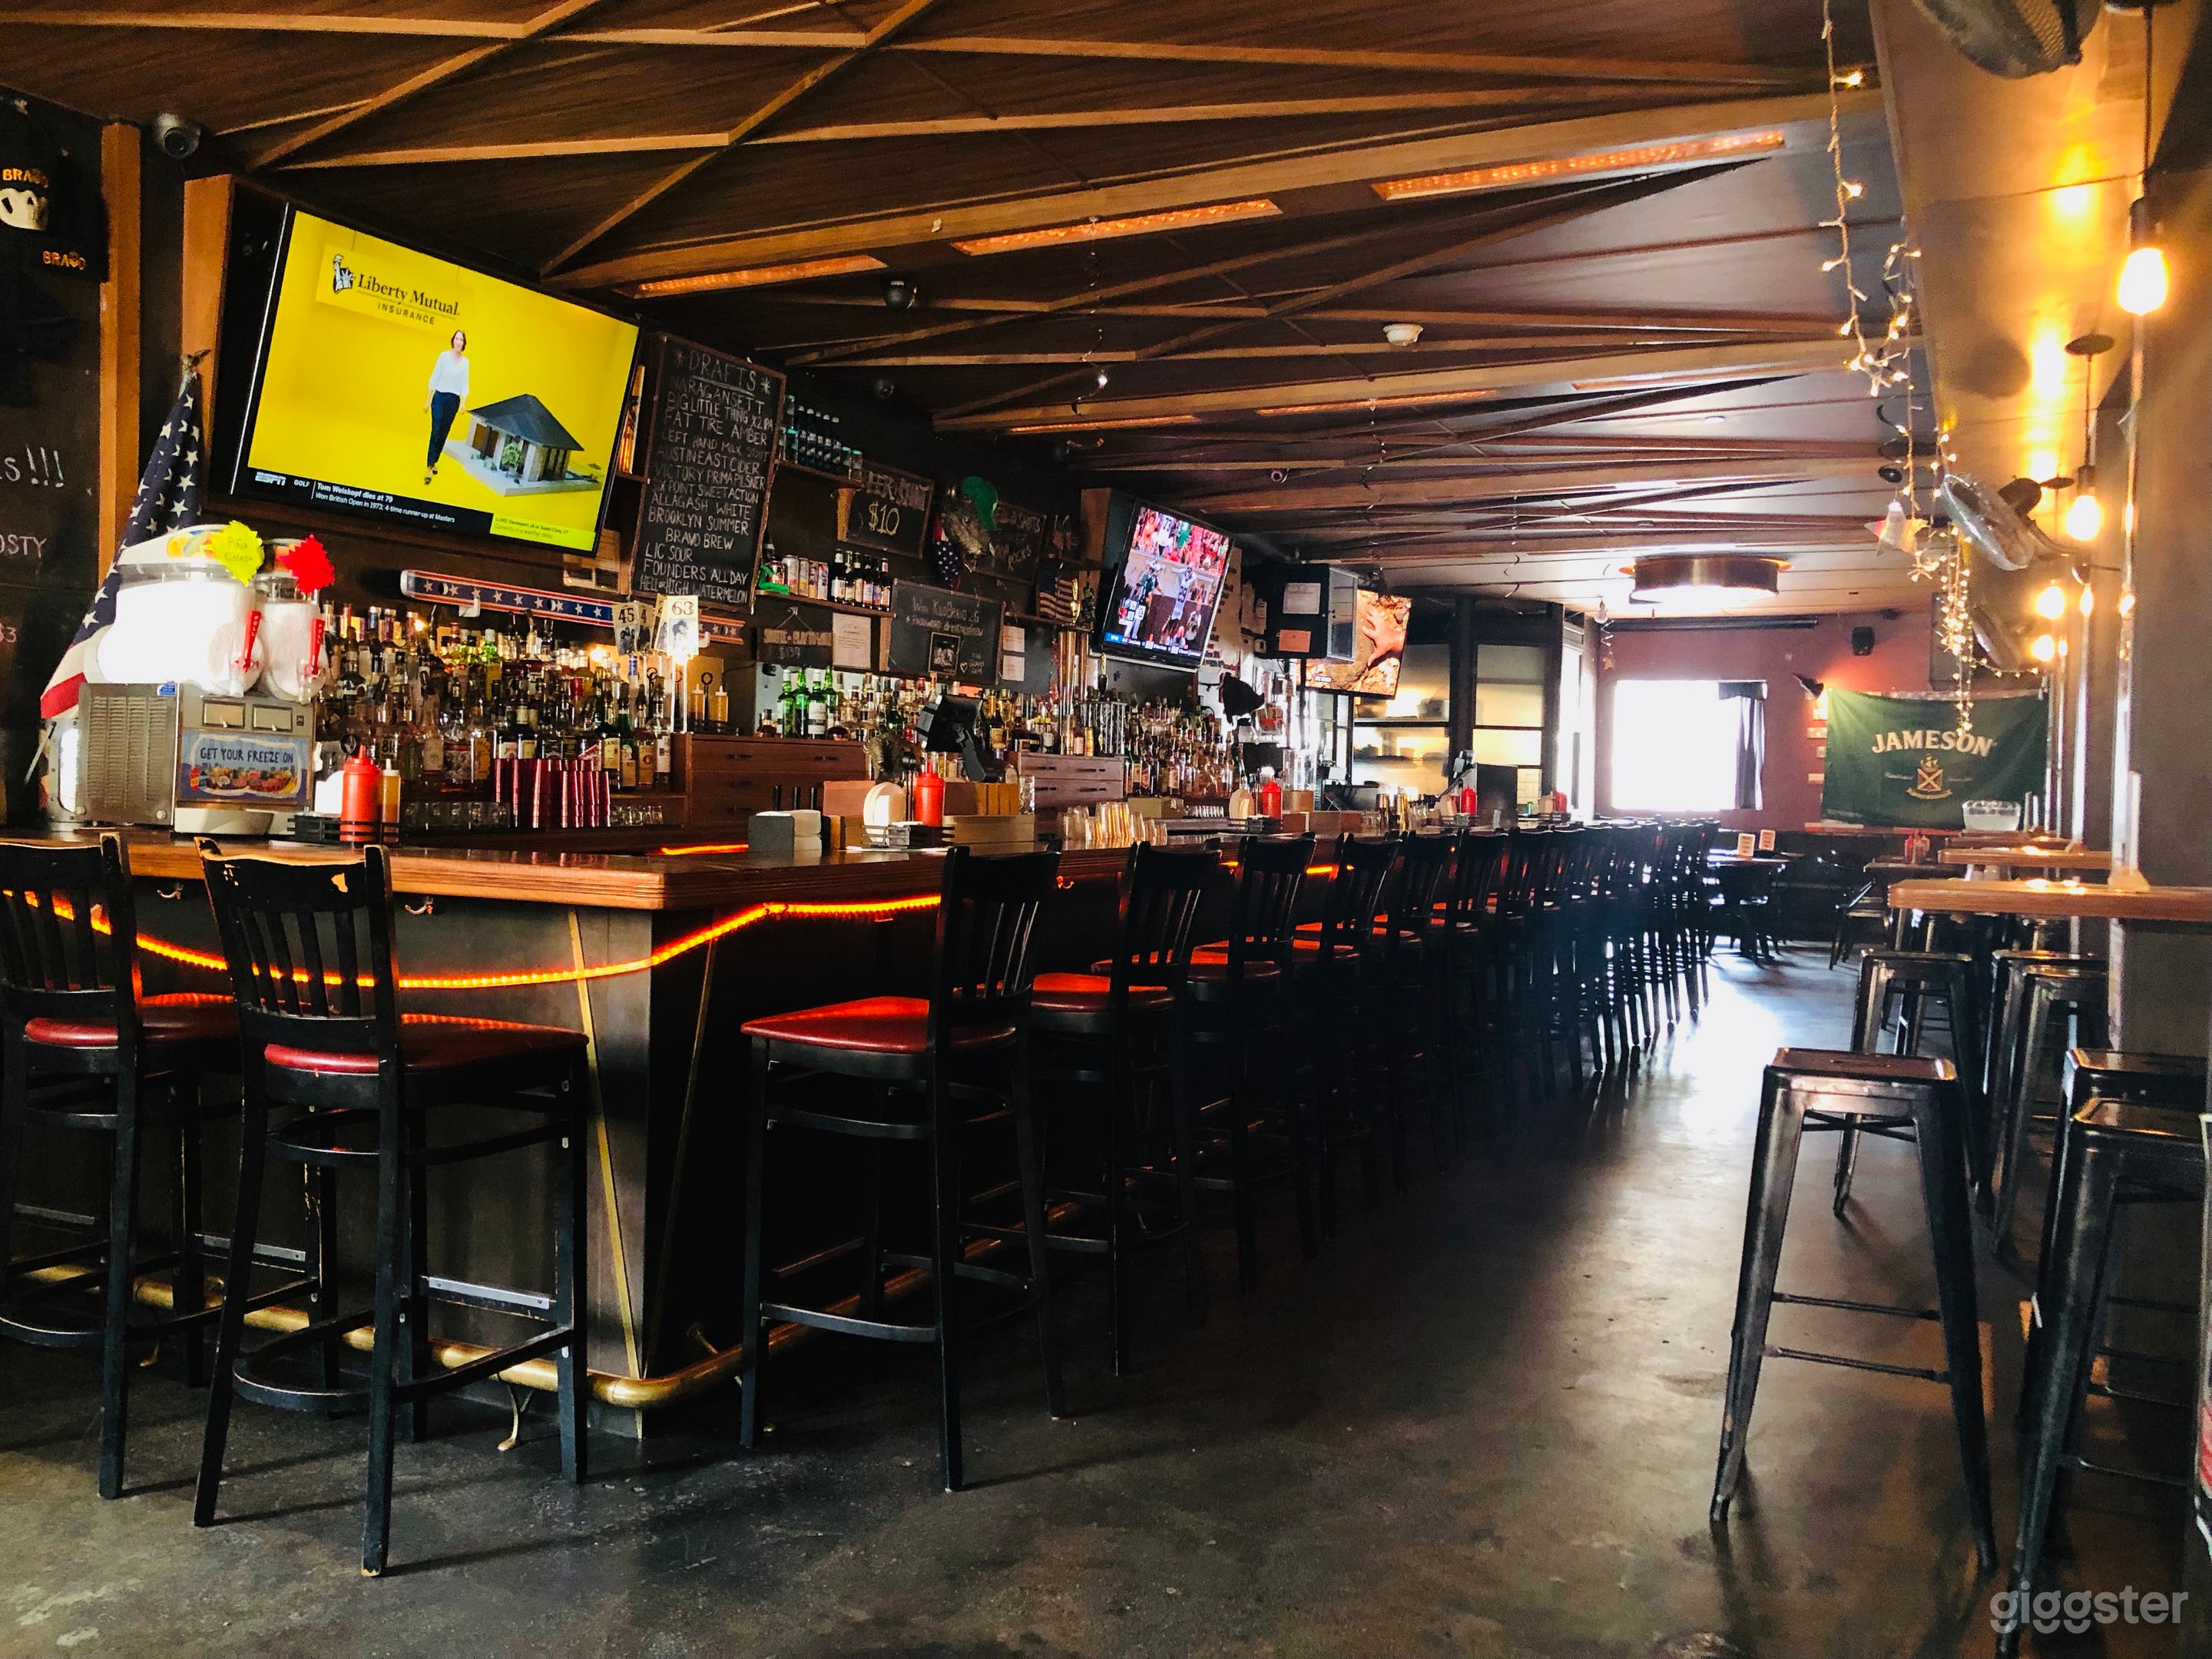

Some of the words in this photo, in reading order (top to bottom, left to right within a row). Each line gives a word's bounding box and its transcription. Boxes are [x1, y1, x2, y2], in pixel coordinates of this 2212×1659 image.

[358, 273, 409, 305] Liberty
[410, 290, 459, 316] Mutual
[377, 302, 435, 325] INSURANCE
[689, 350, 757, 392] DRAFTS
[667, 391, 689, 410] BIG
[691, 398, 720, 418] LITTLE
[661, 429, 689, 445] LEFT
[693, 435, 718, 450] HAND
[664, 408, 693, 428] FAT
[730, 424, 768, 446] AMBER
[654, 462, 703, 483] VICTORY
[730, 456, 760, 475] CIDER
[254, 471, 286, 486] ESPN
[293, 478, 310, 488] GOLF
[317, 482, 331, 492] Tom
[363, 491, 376, 501] dies
[385, 495, 393, 503] 79
[668, 479, 694, 495] POINT
[728, 488, 760, 505] ACTION
[315, 492, 329, 500] Won
[329, 494, 348, 504] British
[348, 498, 363, 508] Open
[435, 513, 455, 523] Masters
[651, 491, 709, 512] ALLAGASH
[716, 501, 752, 521] WHITE
[868, 501, 900, 536] $10
[648, 505, 702, 529] BROOKLYN
[706, 515, 749, 536] SUMMER
[645, 541, 664, 559] LIC
[667, 546, 694, 562] SOUR
[665, 527, 701, 547] BRAVO
[703, 533, 734, 550] BREW
[644, 558, 707, 581] FOUNDERS
[710, 568, 729, 584] ALL
[730, 570, 749, 586] DAY
[639, 574, 658, 592] HELL
[665, 579, 689, 596] HIGH
[692, 584, 749, 604] WATERMELON
[618, 607, 635, 624] 45
[671, 601, 695, 616] 63
[200, 747, 219, 760] GET
[220, 747, 244, 761] YOUR
[247, 750, 280, 764] FREEZE
[283, 753, 293, 763] ON
[1871, 729, 1993, 758] JAMESON
